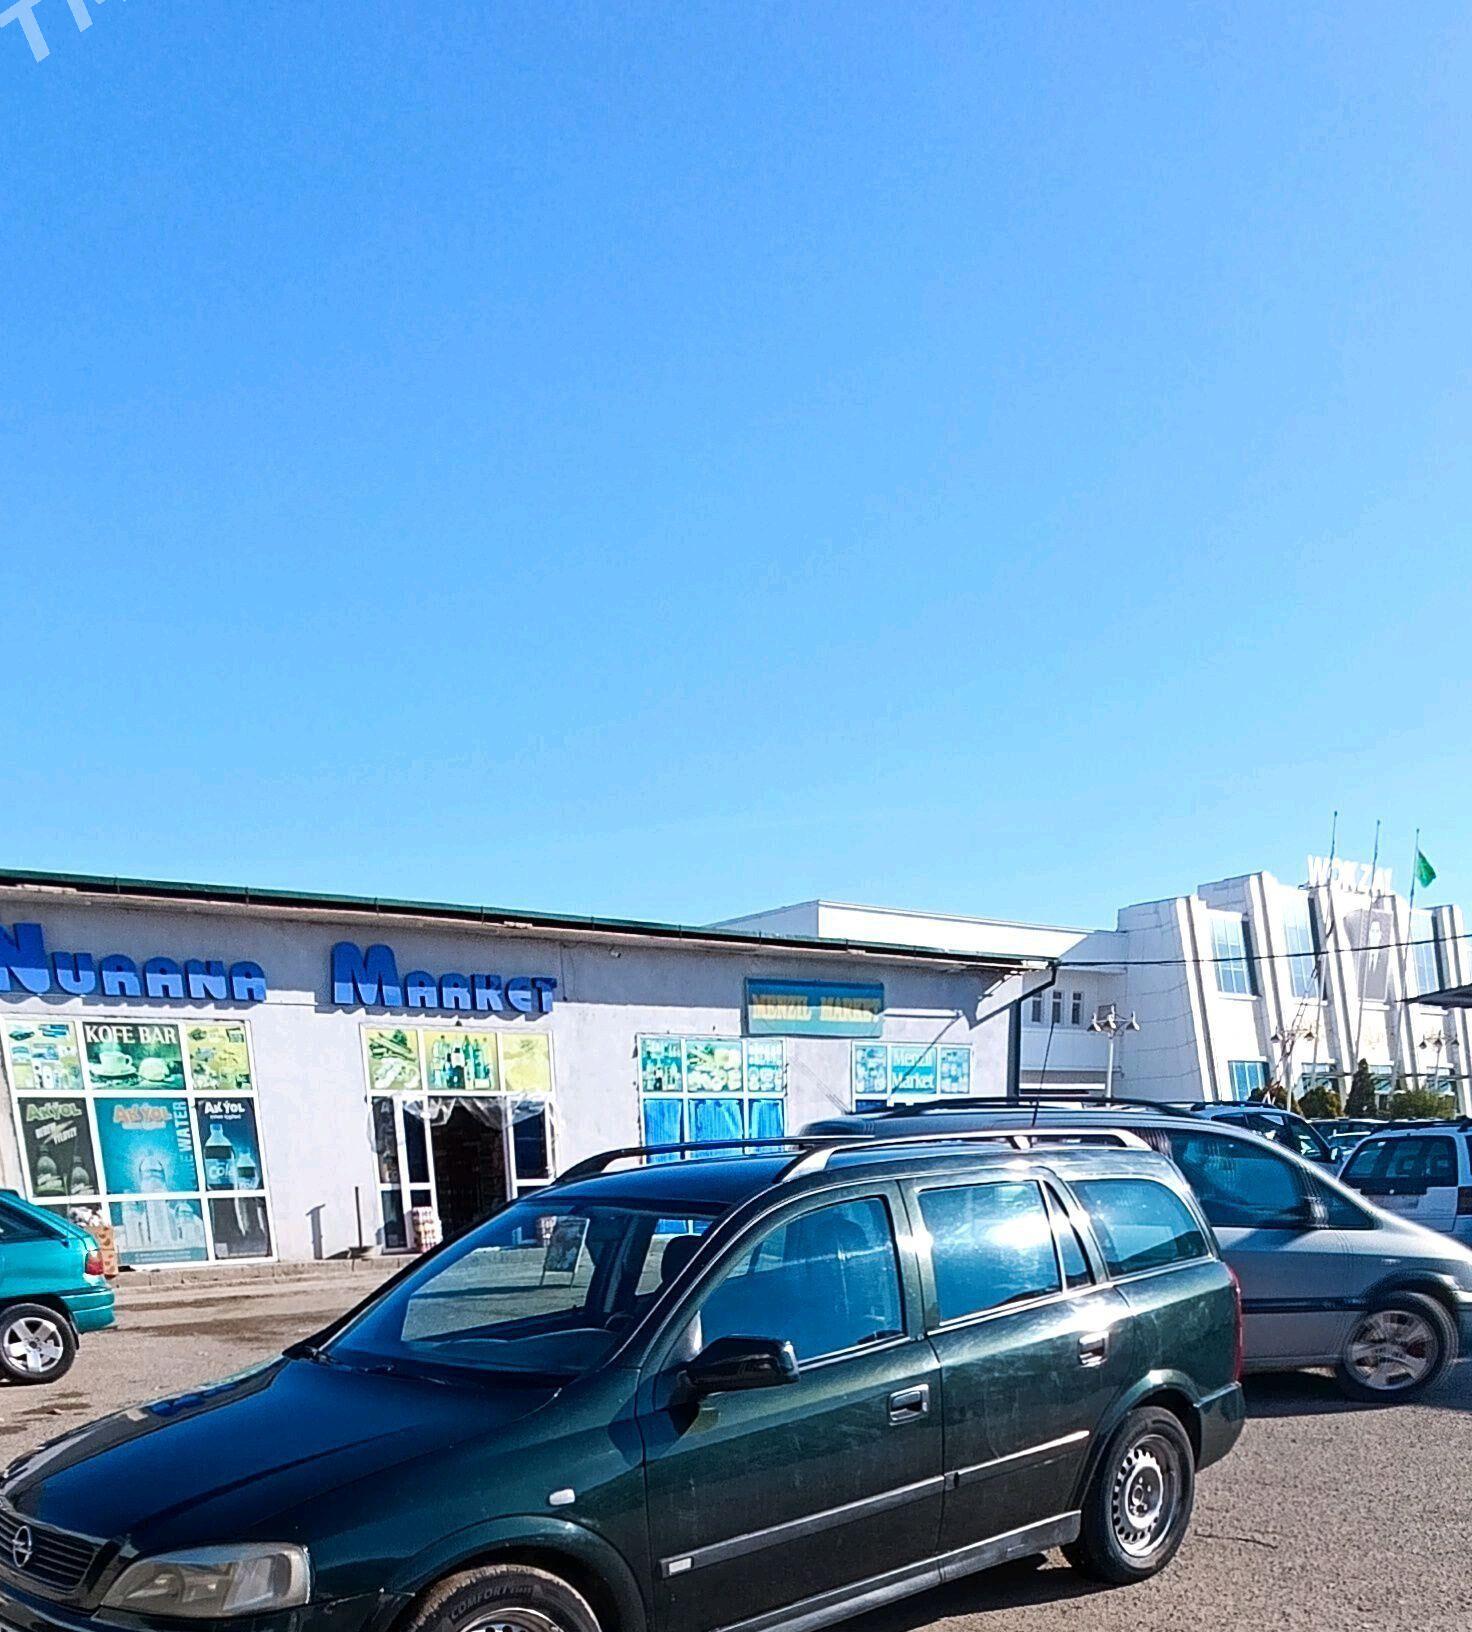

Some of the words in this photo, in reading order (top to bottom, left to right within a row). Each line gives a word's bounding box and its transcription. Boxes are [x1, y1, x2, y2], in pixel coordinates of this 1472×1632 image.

[85, 1024, 135, 1043] KOFE
[139, 1026, 177, 1044] BAR
[172, 1101, 193, 1152] WATER
